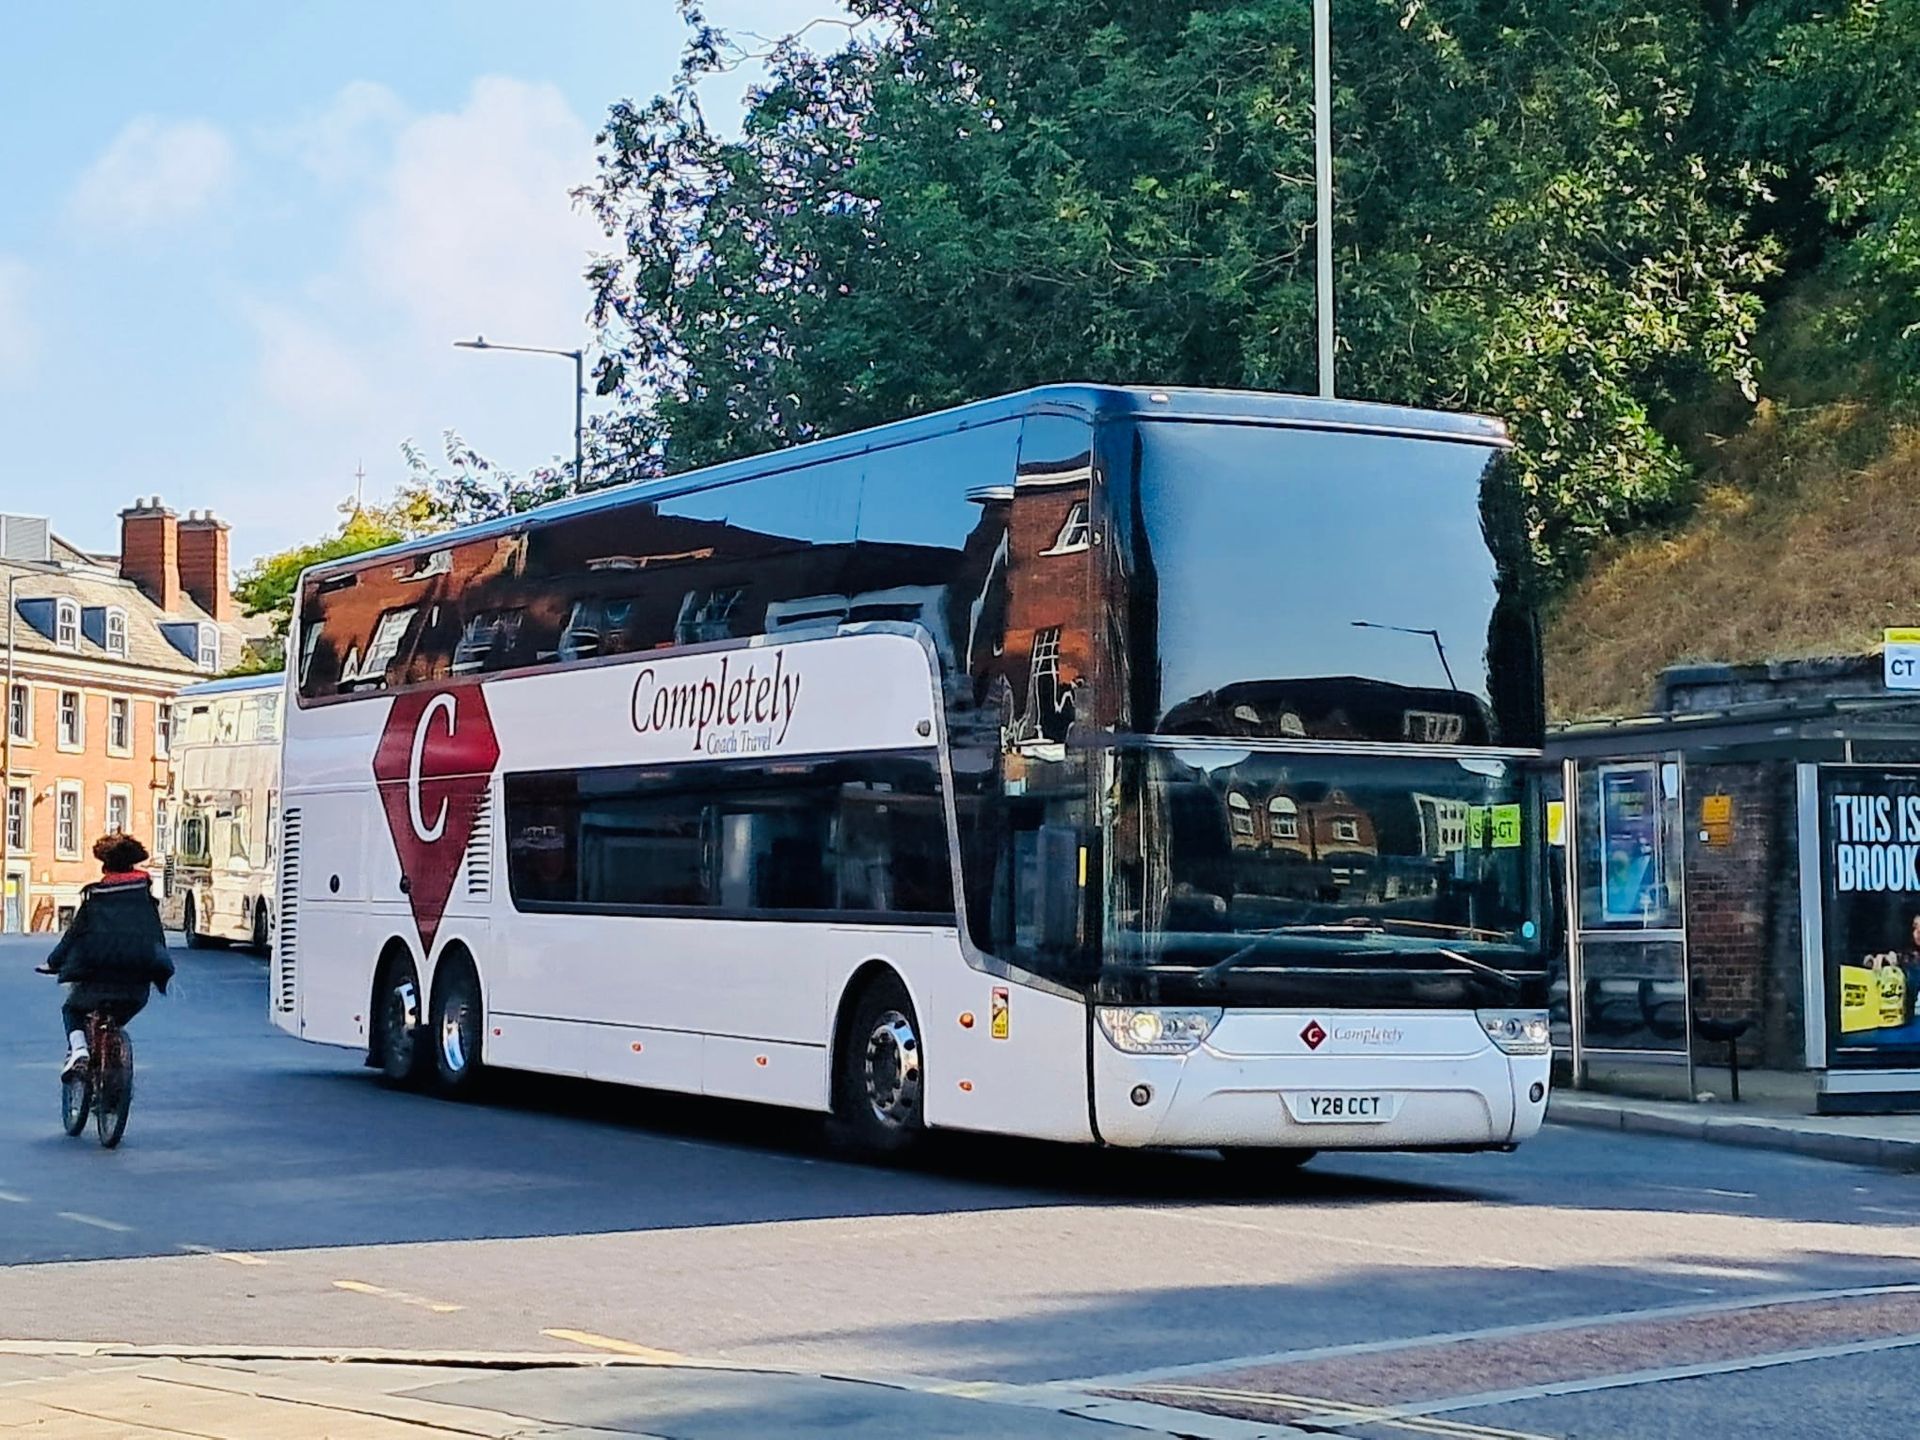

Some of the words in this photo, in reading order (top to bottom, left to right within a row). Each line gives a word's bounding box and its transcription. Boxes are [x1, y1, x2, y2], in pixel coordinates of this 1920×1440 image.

[1891, 659, 1915, 676] CT
[631, 649, 800, 751] Completely
[706, 730, 737, 755] Coach
[740, 727, 772, 752] Travel
[408, 693, 457, 842] C
[1834, 795, 1891, 842] THIS
[1897, 795, 1920, 842] IS
[1838, 844, 1920, 891] BROOK
[1307, 1027, 1322, 1042] C
[1334, 1026, 1404, 1044] Completely
[1310, 1097, 1343, 1115] Y28
[1348, 1097, 1380, 1115] CCT
